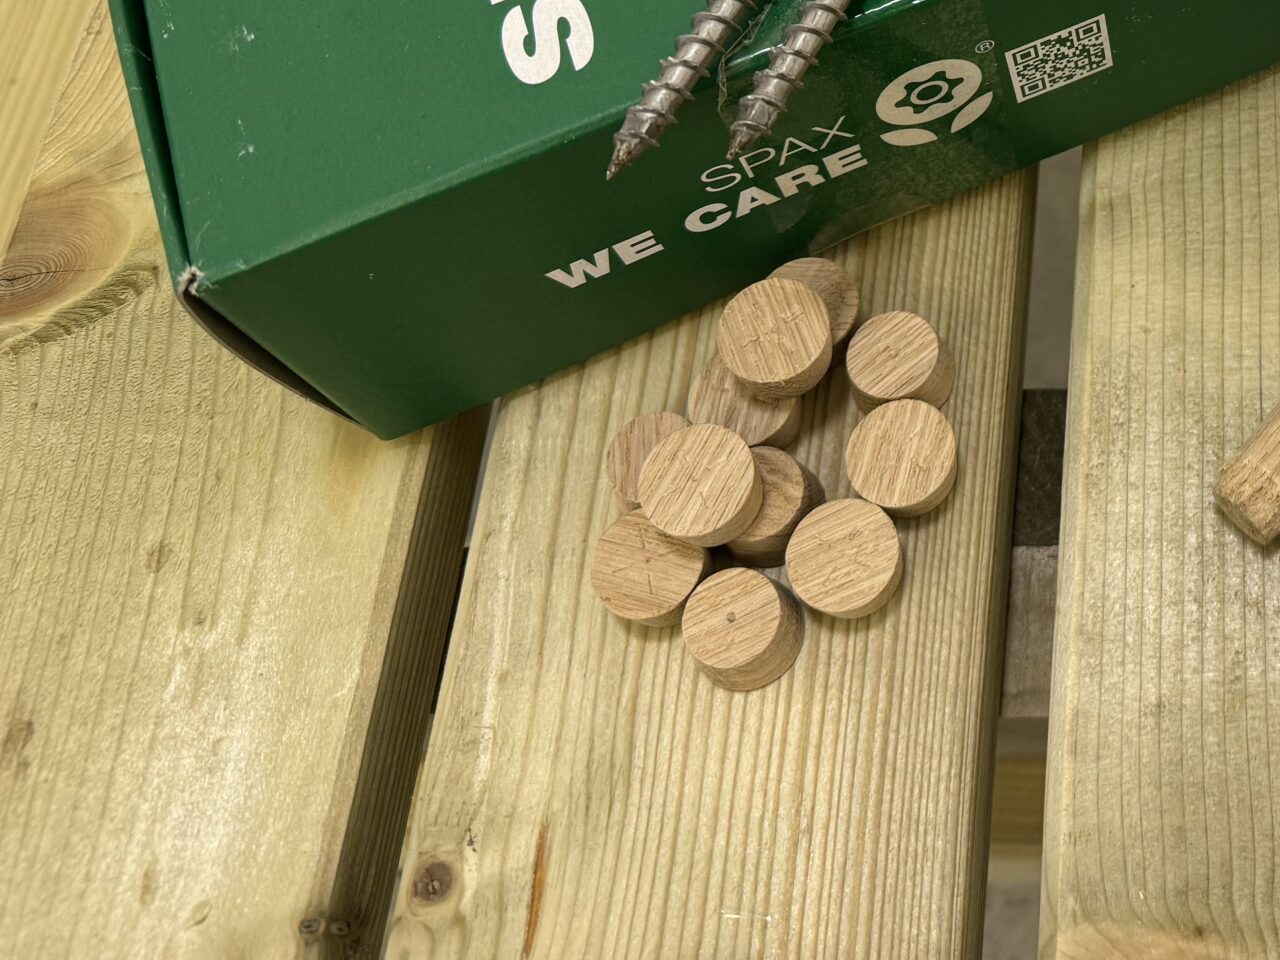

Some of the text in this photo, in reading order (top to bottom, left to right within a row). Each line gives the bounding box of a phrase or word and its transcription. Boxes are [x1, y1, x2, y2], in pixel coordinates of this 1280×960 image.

[700, 115, 856, 193] SPAX
[544, 144, 869, 289] WE CARE
